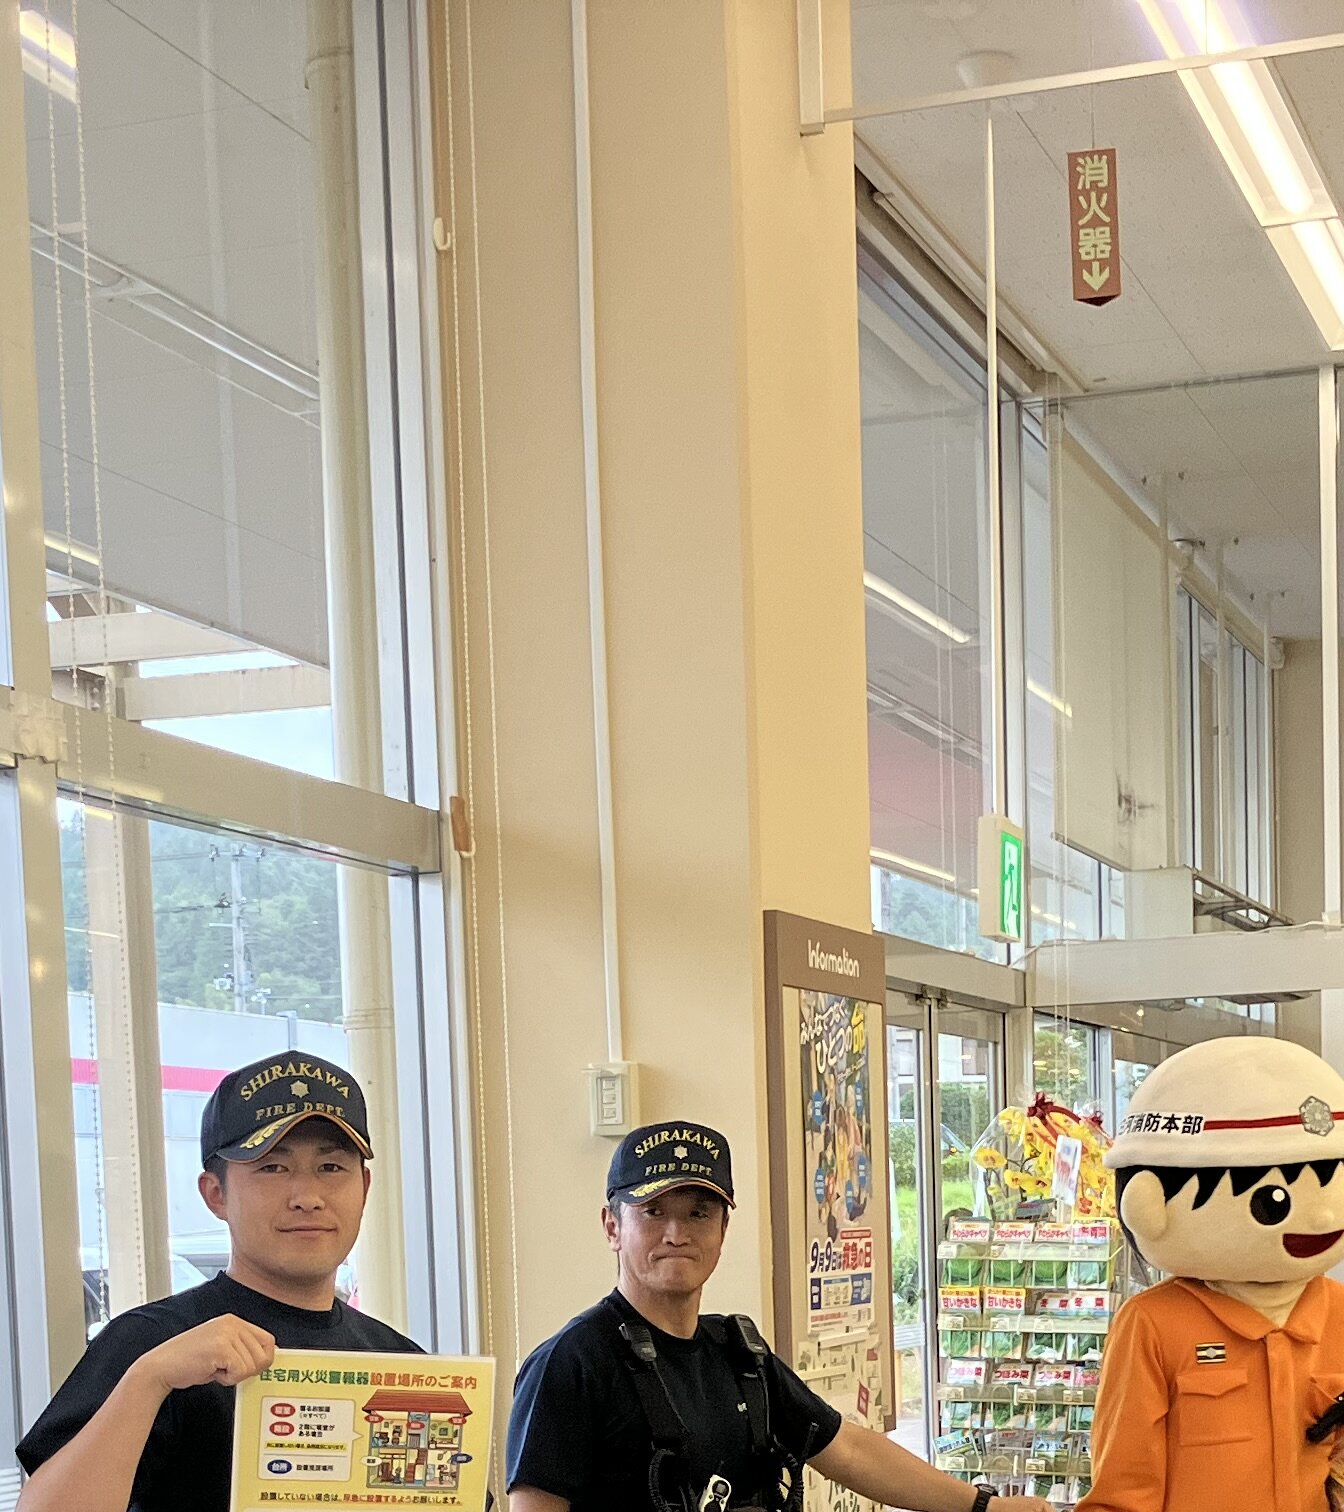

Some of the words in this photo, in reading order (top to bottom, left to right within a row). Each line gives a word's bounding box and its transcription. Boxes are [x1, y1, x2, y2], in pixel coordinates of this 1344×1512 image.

[1076, 154, 1112, 261] 消火器
[807, 939, 860, 978] Information
[815, 1003, 866, 1074] ひとつの命
[240, 1061, 350, 1101] SHIRAKAWA
[256, 1103, 296, 1120] FIRE
[304, 1102, 346, 1117] DEPT.
[635, 1129, 721, 1160] SHIRAKAWA
[645, 1163, 676, 1176] FIRE
[810, 1241, 872, 1273] 9月9日は救急の日
[260, 1368, 477, 1390] 住宅用火災警報器設置場所のご案内
